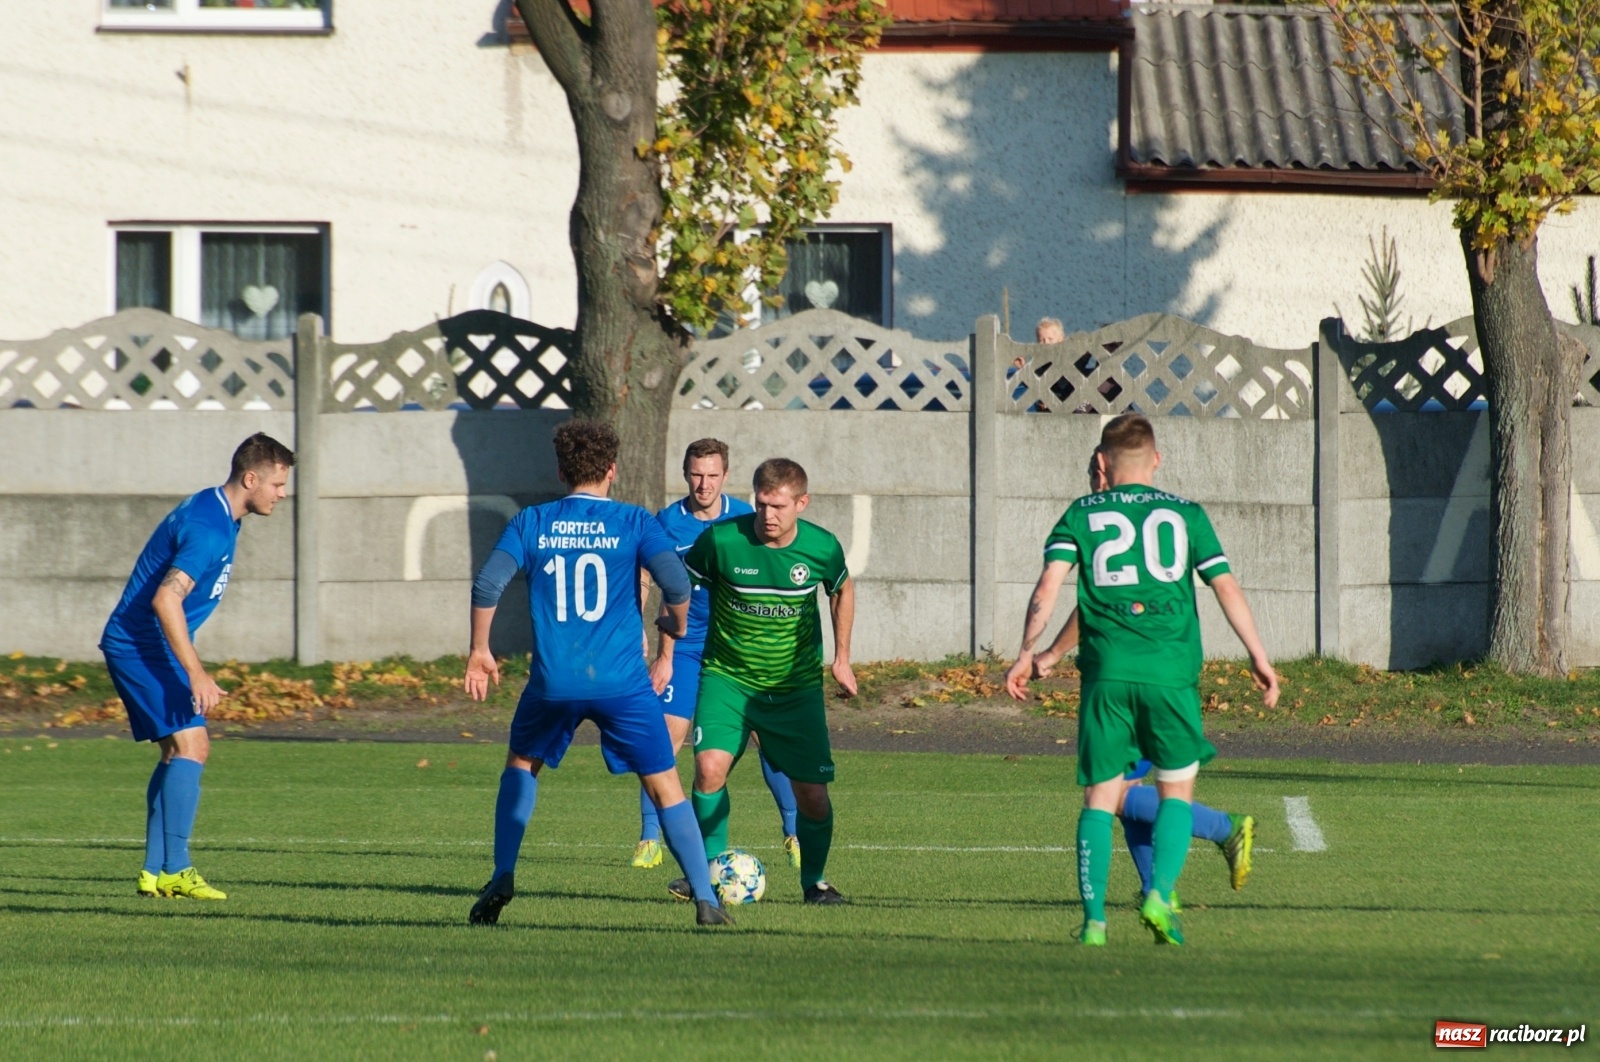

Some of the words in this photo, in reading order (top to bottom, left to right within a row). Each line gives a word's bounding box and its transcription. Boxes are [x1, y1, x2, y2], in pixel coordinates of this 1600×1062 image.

[1110, 492, 1191, 505] TWORKO
[551, 520, 606, 535] FORTECA
[538, 534, 620, 549] ŚWIERKLANY
[1088, 507, 1189, 587] 20
[543, 552, 608, 622] 10
